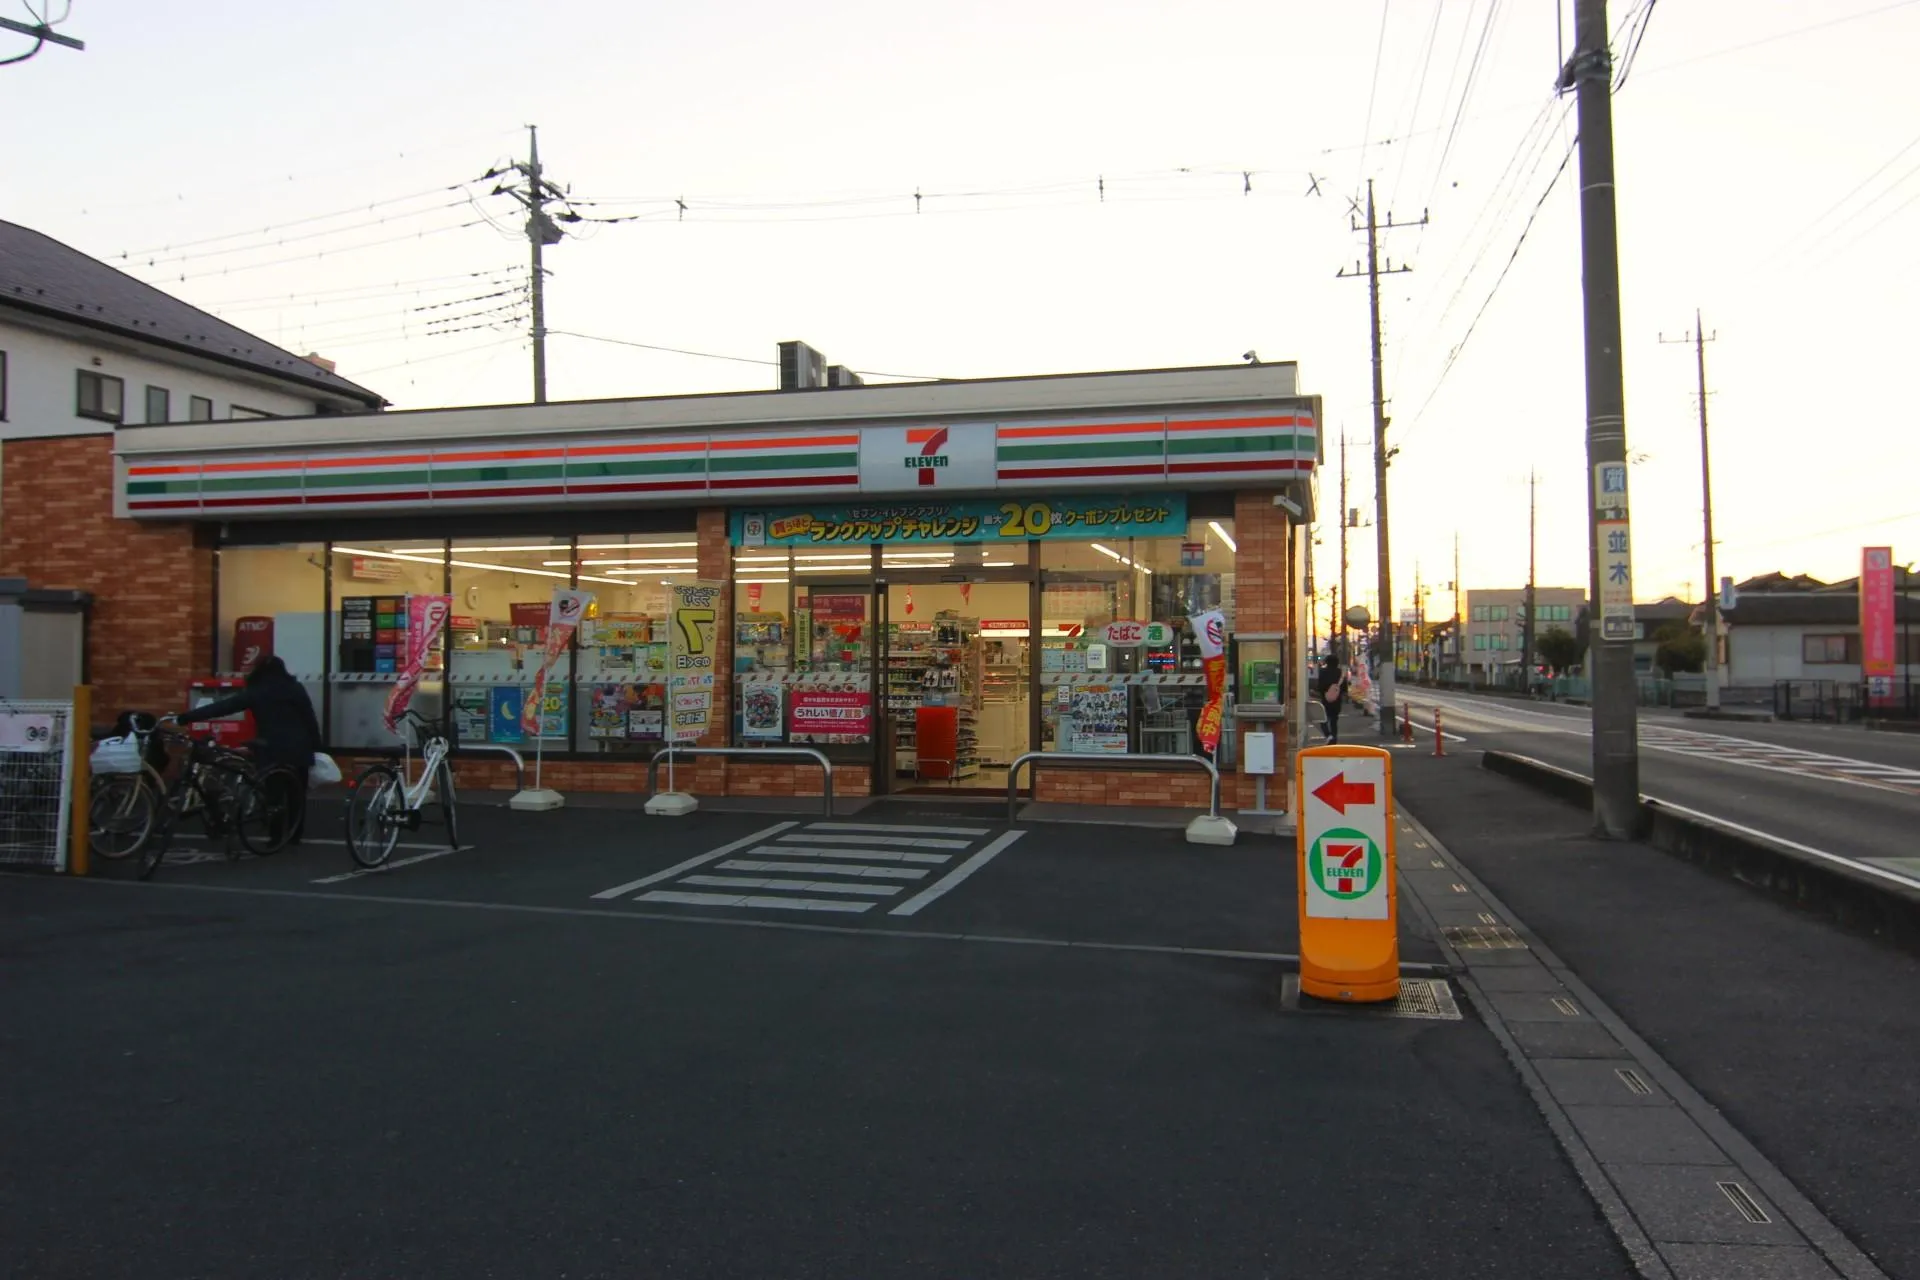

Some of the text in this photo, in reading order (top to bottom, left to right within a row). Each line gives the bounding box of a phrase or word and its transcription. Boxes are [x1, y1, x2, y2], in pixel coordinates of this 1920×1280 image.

[906, 427, 948, 485] 7
[810, 516, 980, 542] ランクアップチャレンジ
[1065, 507, 1169, 526] クーポンプレゼント
[1607, 530, 1629, 586] 並木
[1107, 625, 1142, 641] たばこ
[1147, 625, 1163, 641] 酒
[1326, 845, 1364, 893] 7
